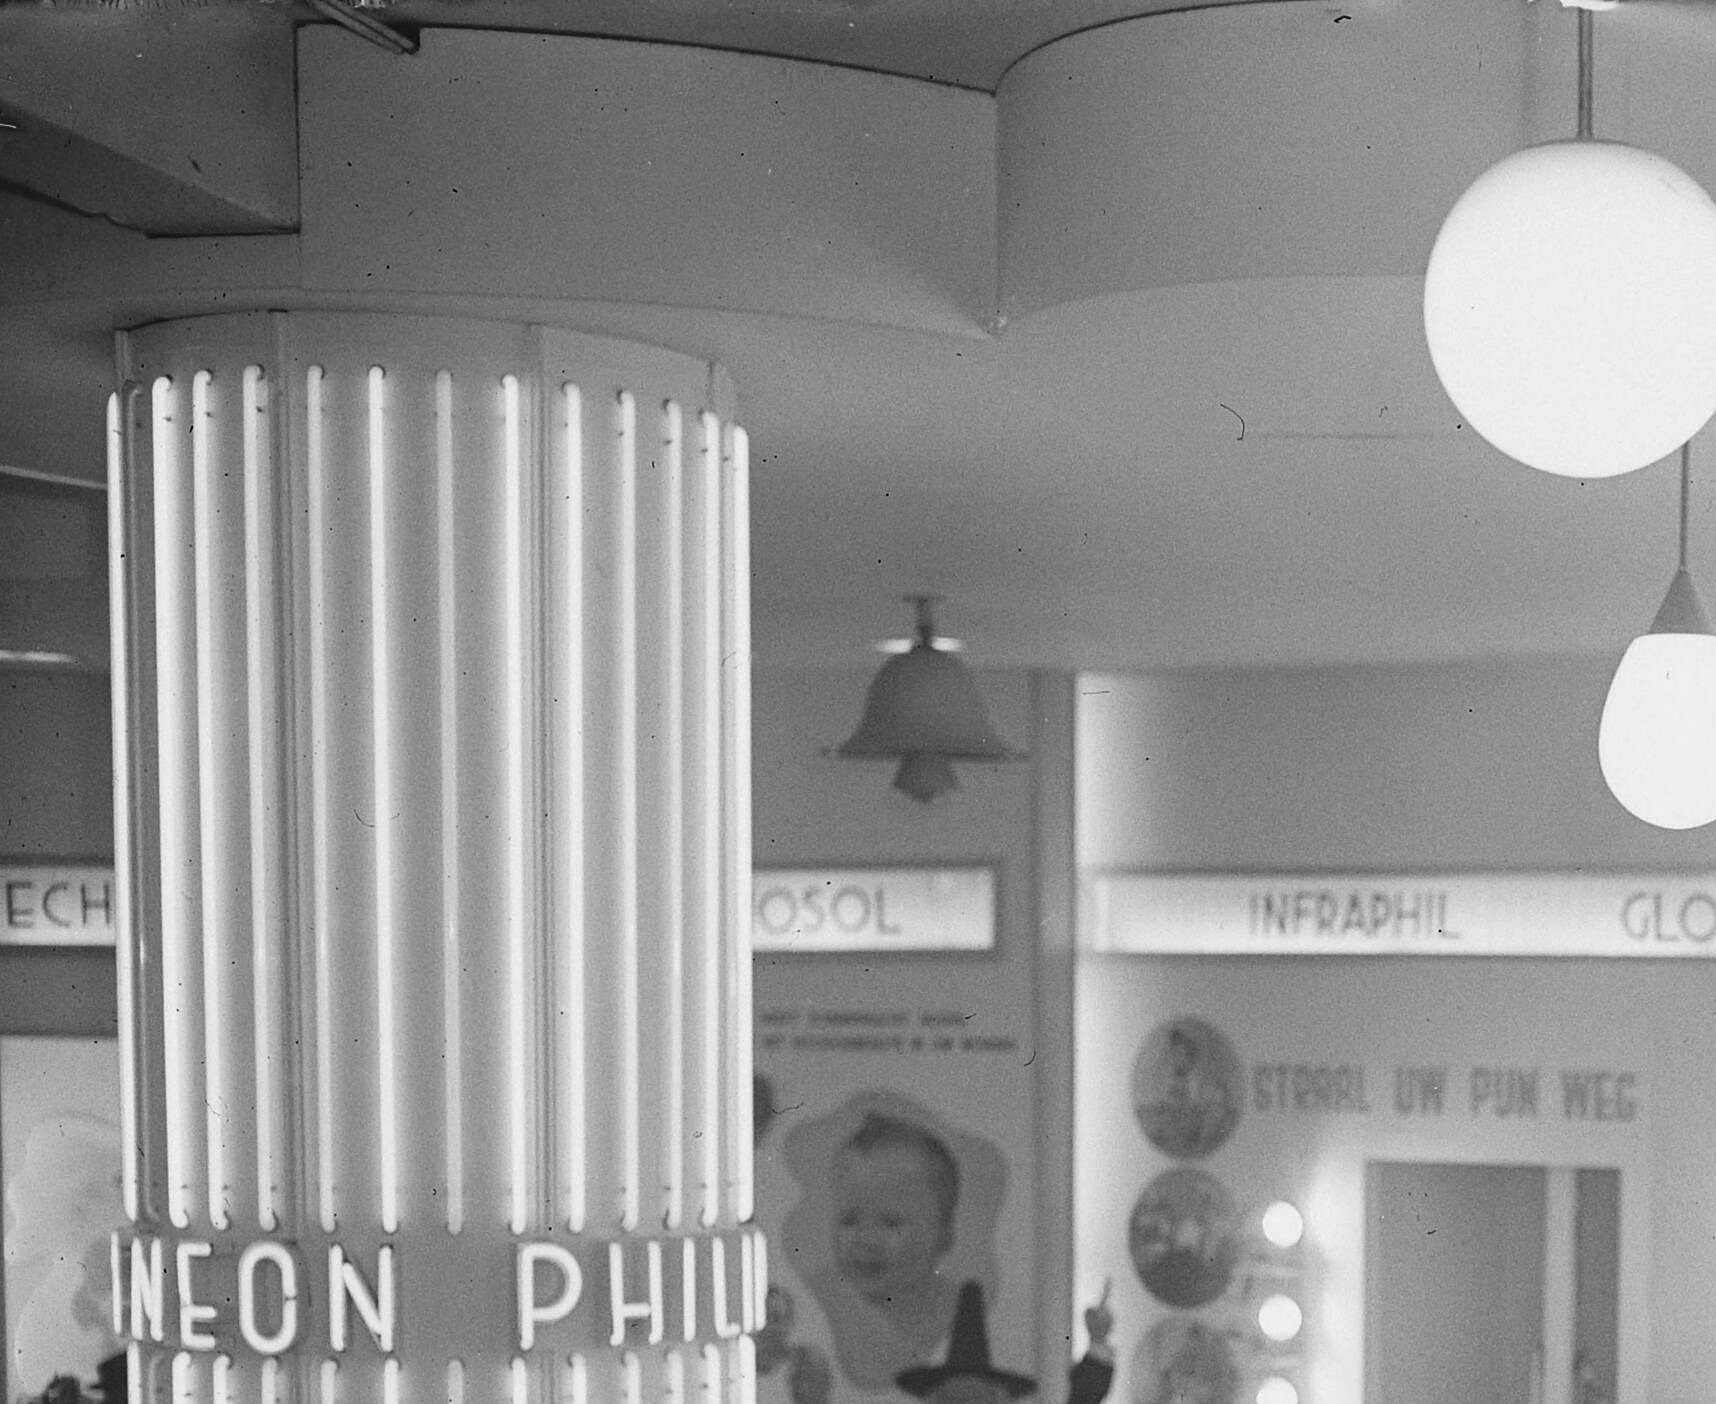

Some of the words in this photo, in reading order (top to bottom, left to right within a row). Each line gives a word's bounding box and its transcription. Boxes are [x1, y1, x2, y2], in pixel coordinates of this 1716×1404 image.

[1248, 889, 1462, 940] INFRAPHIL
[1253, 1064, 1370, 1113] STRAAL
[1393, 1066, 1449, 1117] UW
[1560, 1070, 1638, 1122] WEG
[131, 1236, 396, 1353] NEON
